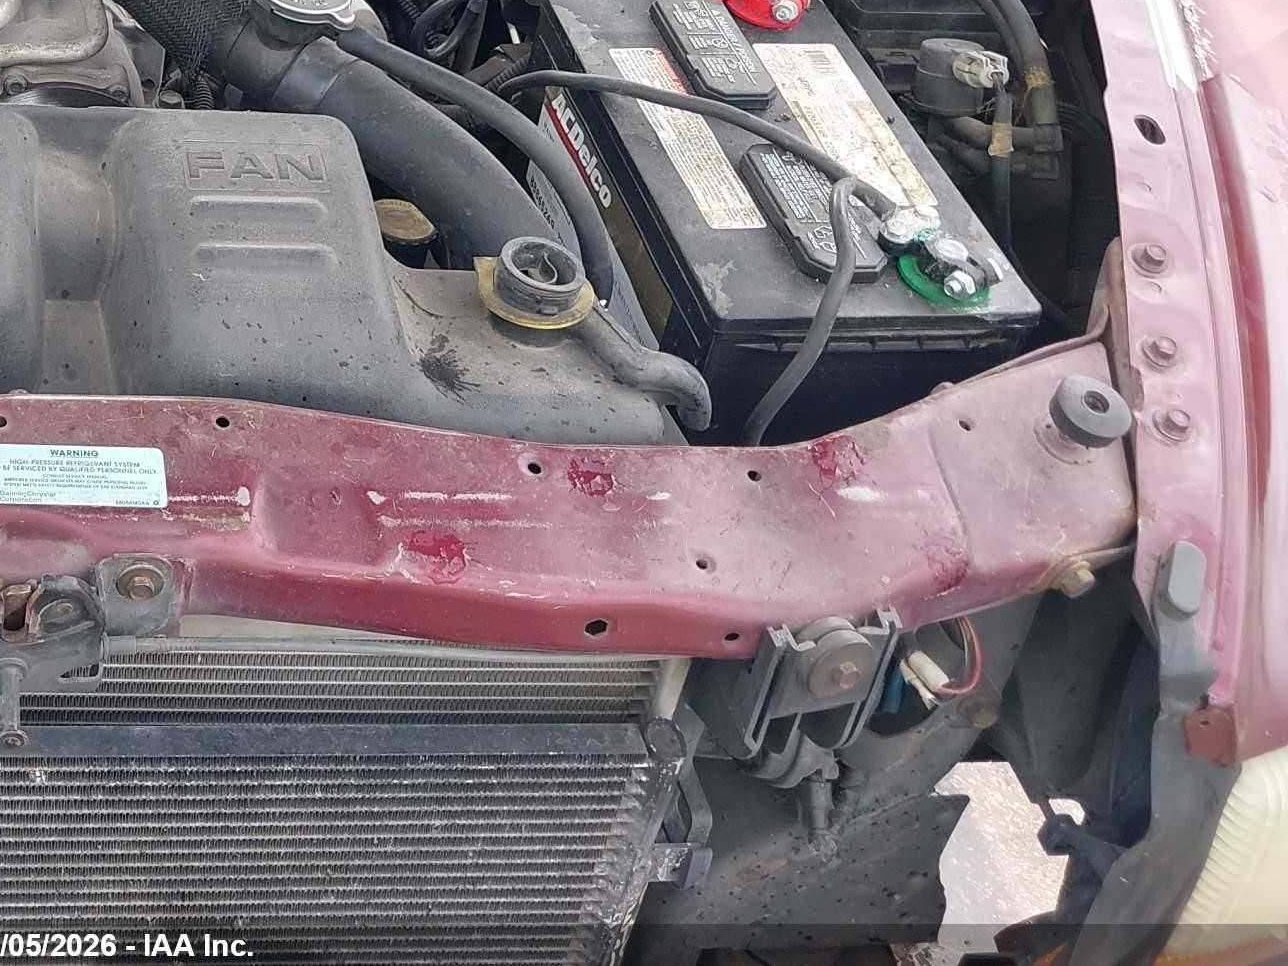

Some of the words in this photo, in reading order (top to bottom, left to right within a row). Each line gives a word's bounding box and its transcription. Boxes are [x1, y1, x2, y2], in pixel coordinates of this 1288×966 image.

[715, 16, 738, 41] DANGER
[735, 48, 757, 72] POISON
[186, 149, 325, 181] FAN
[551, 92, 613, 210] ACDelco
[50, 450, 99, 458] WARNING
